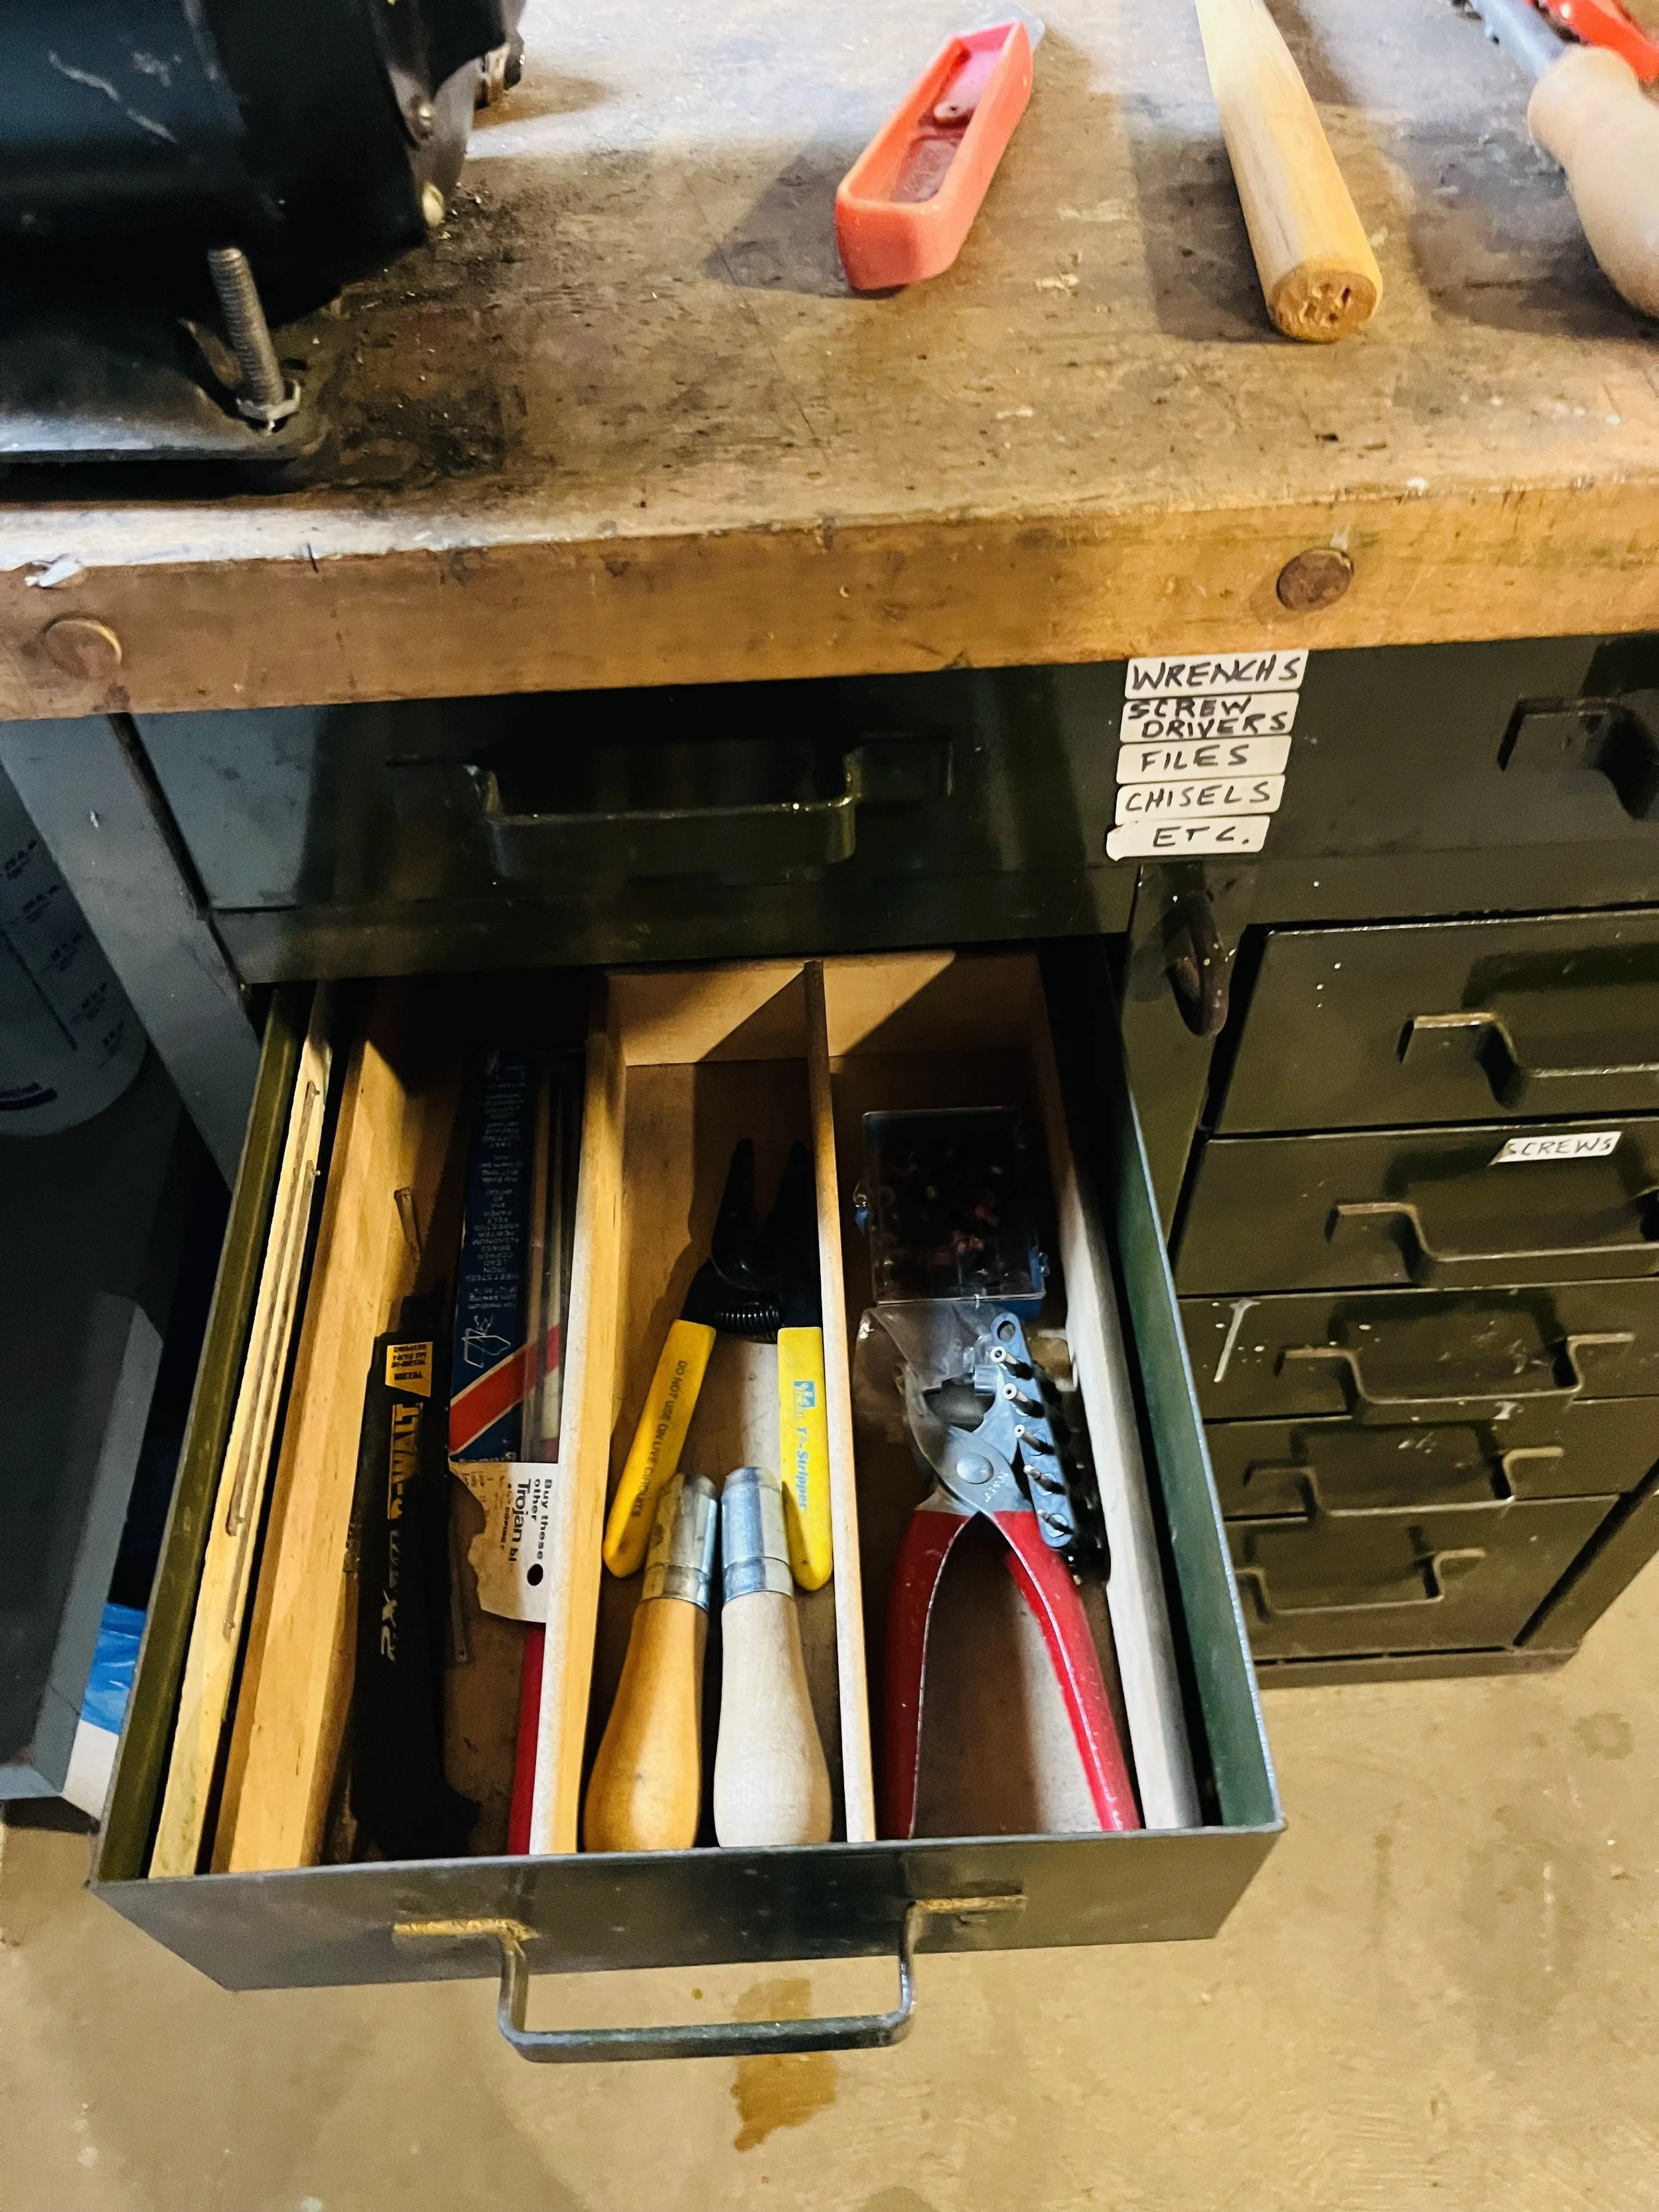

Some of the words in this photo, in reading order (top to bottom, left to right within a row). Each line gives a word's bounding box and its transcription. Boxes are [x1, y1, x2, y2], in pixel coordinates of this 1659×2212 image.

[1132, 654, 1301, 690] WRENCHS
[1128, 697, 1252, 720] SCREW
[1141, 711, 1288, 739] DRIVERS
[1141, 744, 1250, 773] FILES
[1125, 781, 1271, 813] CHISELS
[1504, 1136, 1613, 1155] SCREWS
[676, 1360, 688, 1376] DO
[669, 1376, 683, 1401] NOT
[661, 1400, 675, 1422] USE
[656, 1424, 668, 1441] ON
[647, 1441, 662, 1464] LIVE
[531, 1479, 541, 1521] other
[541, 1479, 553, 1509] Buy
[632, 1466, 655, 1518] CIRCUITS
[511, 1479, 532, 1543] Trojan
[536, 1515, 549, 1560] these
